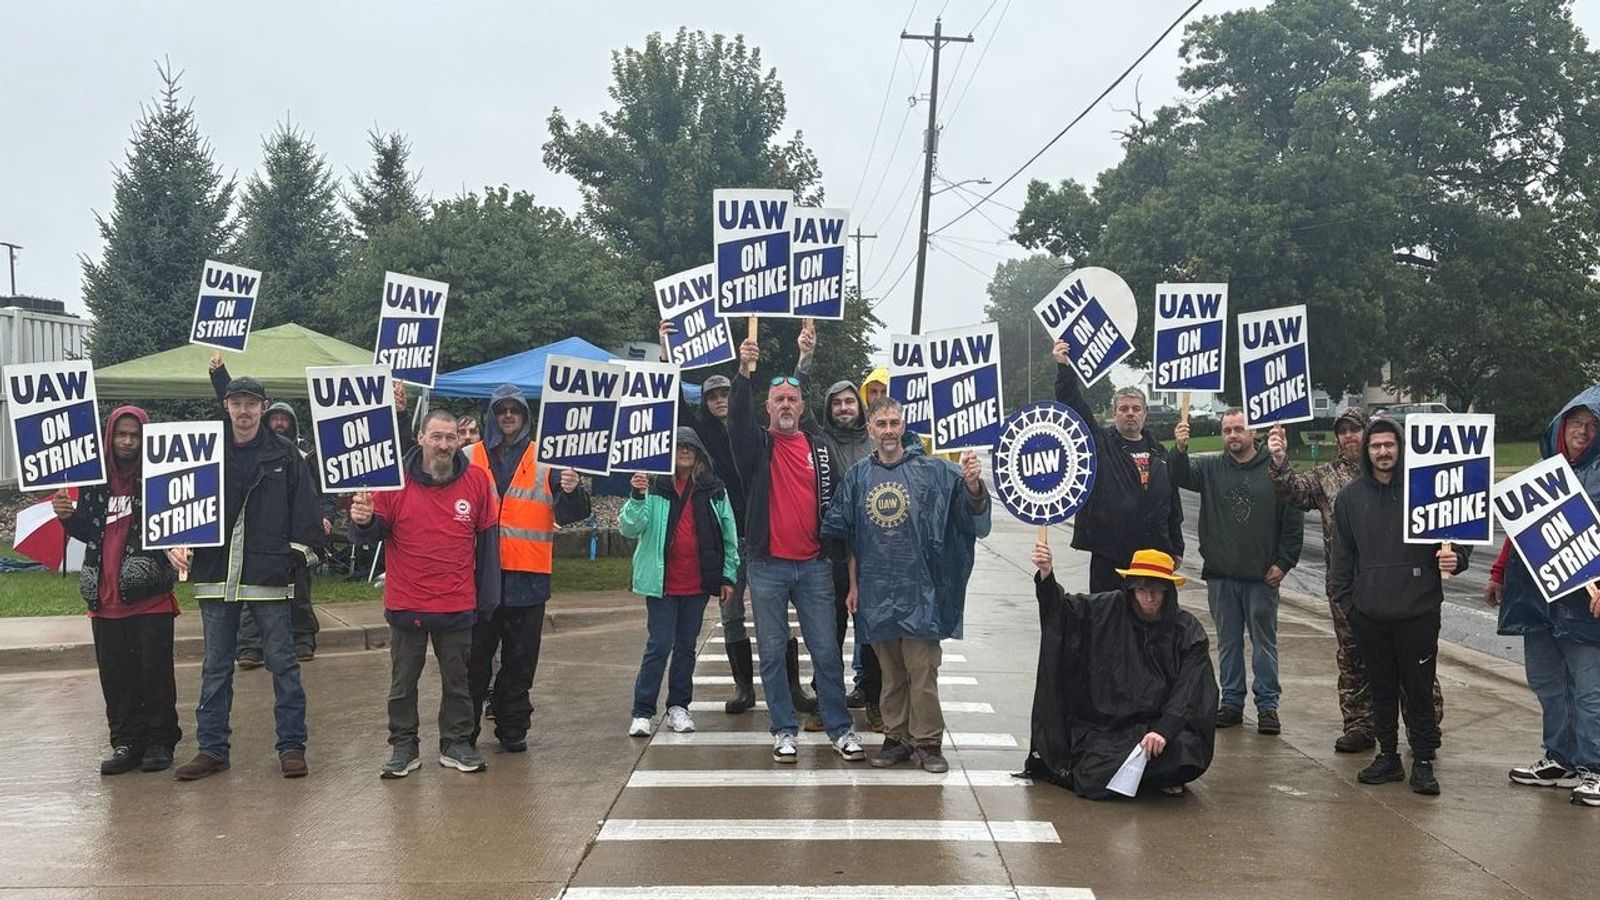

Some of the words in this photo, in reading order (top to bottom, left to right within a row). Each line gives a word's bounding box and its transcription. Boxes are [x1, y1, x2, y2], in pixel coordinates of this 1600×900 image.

[719, 200, 788, 229] UAW
[741, 241, 767, 272] ON
[800, 254, 823, 281] ON
[205, 267, 257, 295] UAW
[660, 273, 713, 309] UAW
[721, 265, 788, 309] STRIKE
[794, 275, 840, 308] TRIKE
[214, 299, 236, 319] ON
[386, 282, 443, 316] UAW
[1040, 278, 1089, 330] UAW
[1158, 294, 1222, 319] UAW
[195, 318, 248, 339] STRIKE
[396, 322, 420, 346] ON
[684, 308, 707, 338] ON
[1072, 318, 1096, 345] ON
[1243, 315, 1303, 350] UAW
[672, 322, 727, 366] STRIKE
[893, 343, 925, 368] UA
[930, 334, 994, 370] UAW
[1076, 319, 1119, 379] STRIKE
[1177, 327, 1202, 354] ON
[549, 365, 619, 399] UAW
[1158, 348, 1219, 386] STRIKE
[1263, 358, 1288, 386] ON
[10, 370, 88, 405] UAW
[312, 375, 387, 408] UAW
[907, 376, 928, 401] ON
[951, 376, 976, 407] ON
[1249, 376, 1307, 421] STRIKE
[40, 411, 71, 446] ON
[342, 416, 370, 448] ON
[565, 406, 593, 431] ON
[629, 407, 654, 434] ON
[936, 402, 998, 444] STRIKE
[146, 432, 219, 464] UAW
[541, 429, 610, 460] STRIKE
[610, 431, 671, 465] STRIKE
[1411, 425, 1488, 455] UAW
[22, 431, 98, 483] STRIKE
[326, 439, 395, 486] STRIKE
[1021, 448, 1062, 478] UAW
[168, 472, 195, 505] ON
[1433, 466, 1464, 499] ON
[1495, 466, 1571, 521] UAW
[148, 495, 218, 543] STRIKE
[878, 497, 899, 510] UAW
[1411, 491, 1487, 535] STRIKE
[1541, 511, 1575, 551] ON
